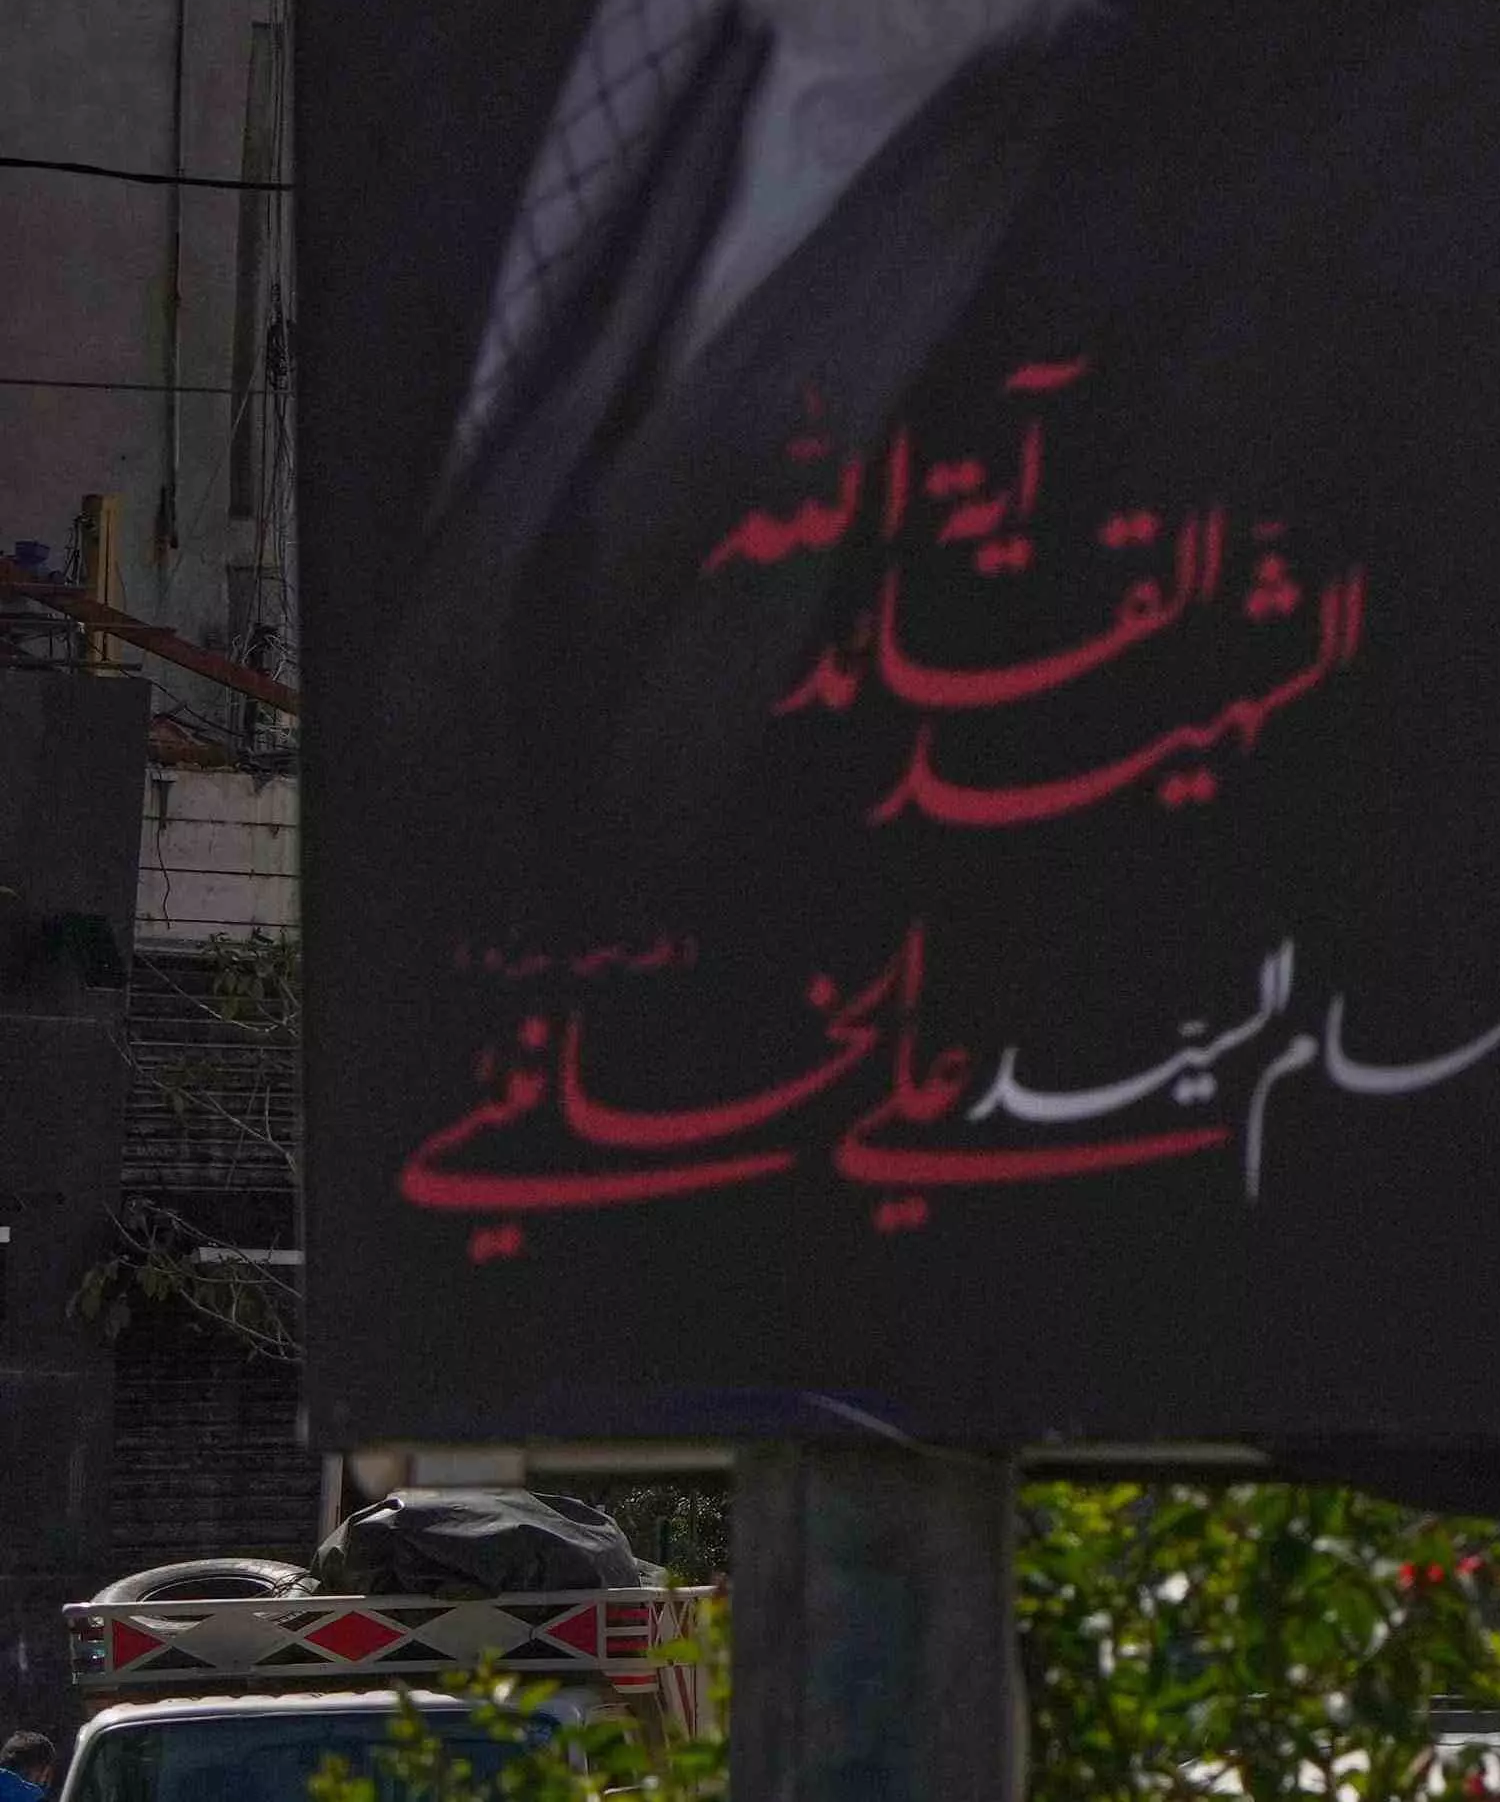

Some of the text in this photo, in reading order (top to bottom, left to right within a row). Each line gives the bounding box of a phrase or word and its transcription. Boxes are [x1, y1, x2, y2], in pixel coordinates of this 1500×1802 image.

[700, 358, 1088, 574] آية الله
[772, 506, 1226, 716] القائد
[866, 521, 1366, 826] الشهيد
[836, 1033, 1232, 1232] علي
[968, 939, 1296, 1123] السيد
